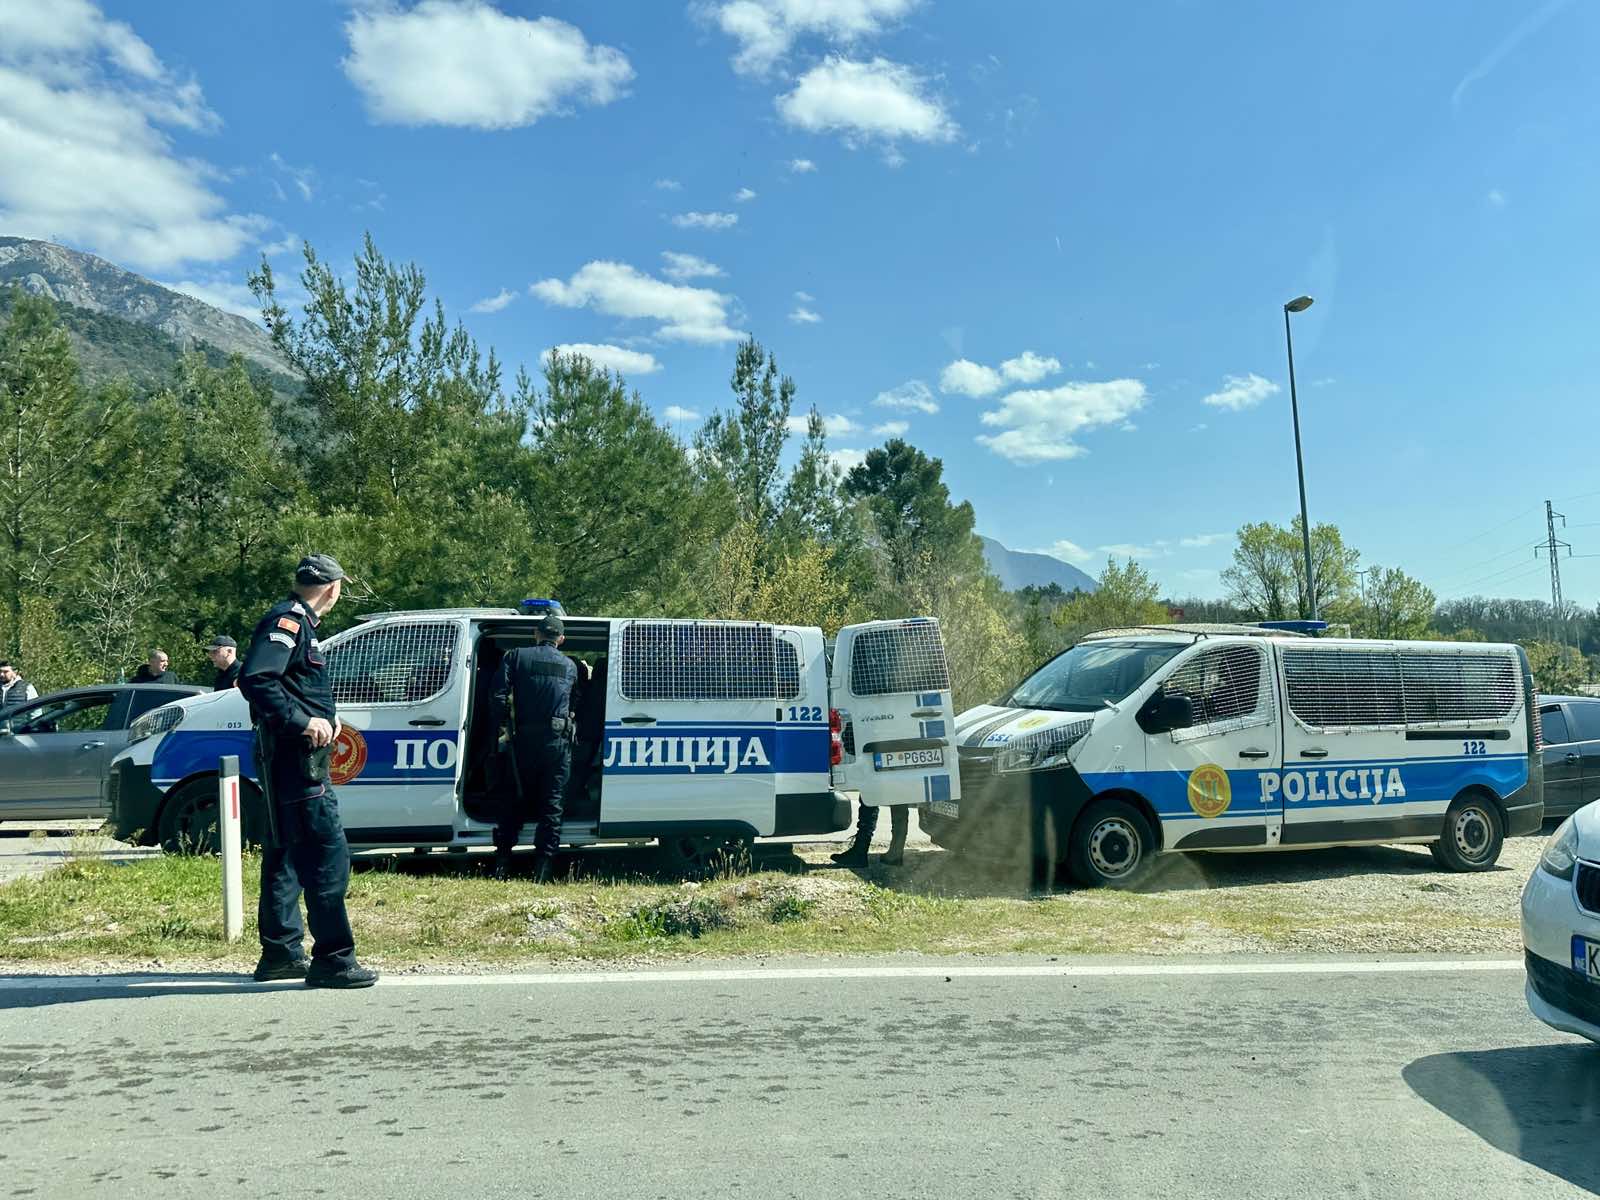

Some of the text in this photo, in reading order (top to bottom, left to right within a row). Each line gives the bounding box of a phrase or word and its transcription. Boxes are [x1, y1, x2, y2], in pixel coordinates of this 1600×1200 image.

[789, 706, 822, 721] 122
[393, 737, 770, 773] ПО ЛИЦИЈА
[1463, 740, 1486, 754] 122
[886, 754, 894, 766] P
[904, 750, 941, 764] PG634
[1258, 768, 1406, 804] POLICIJA
